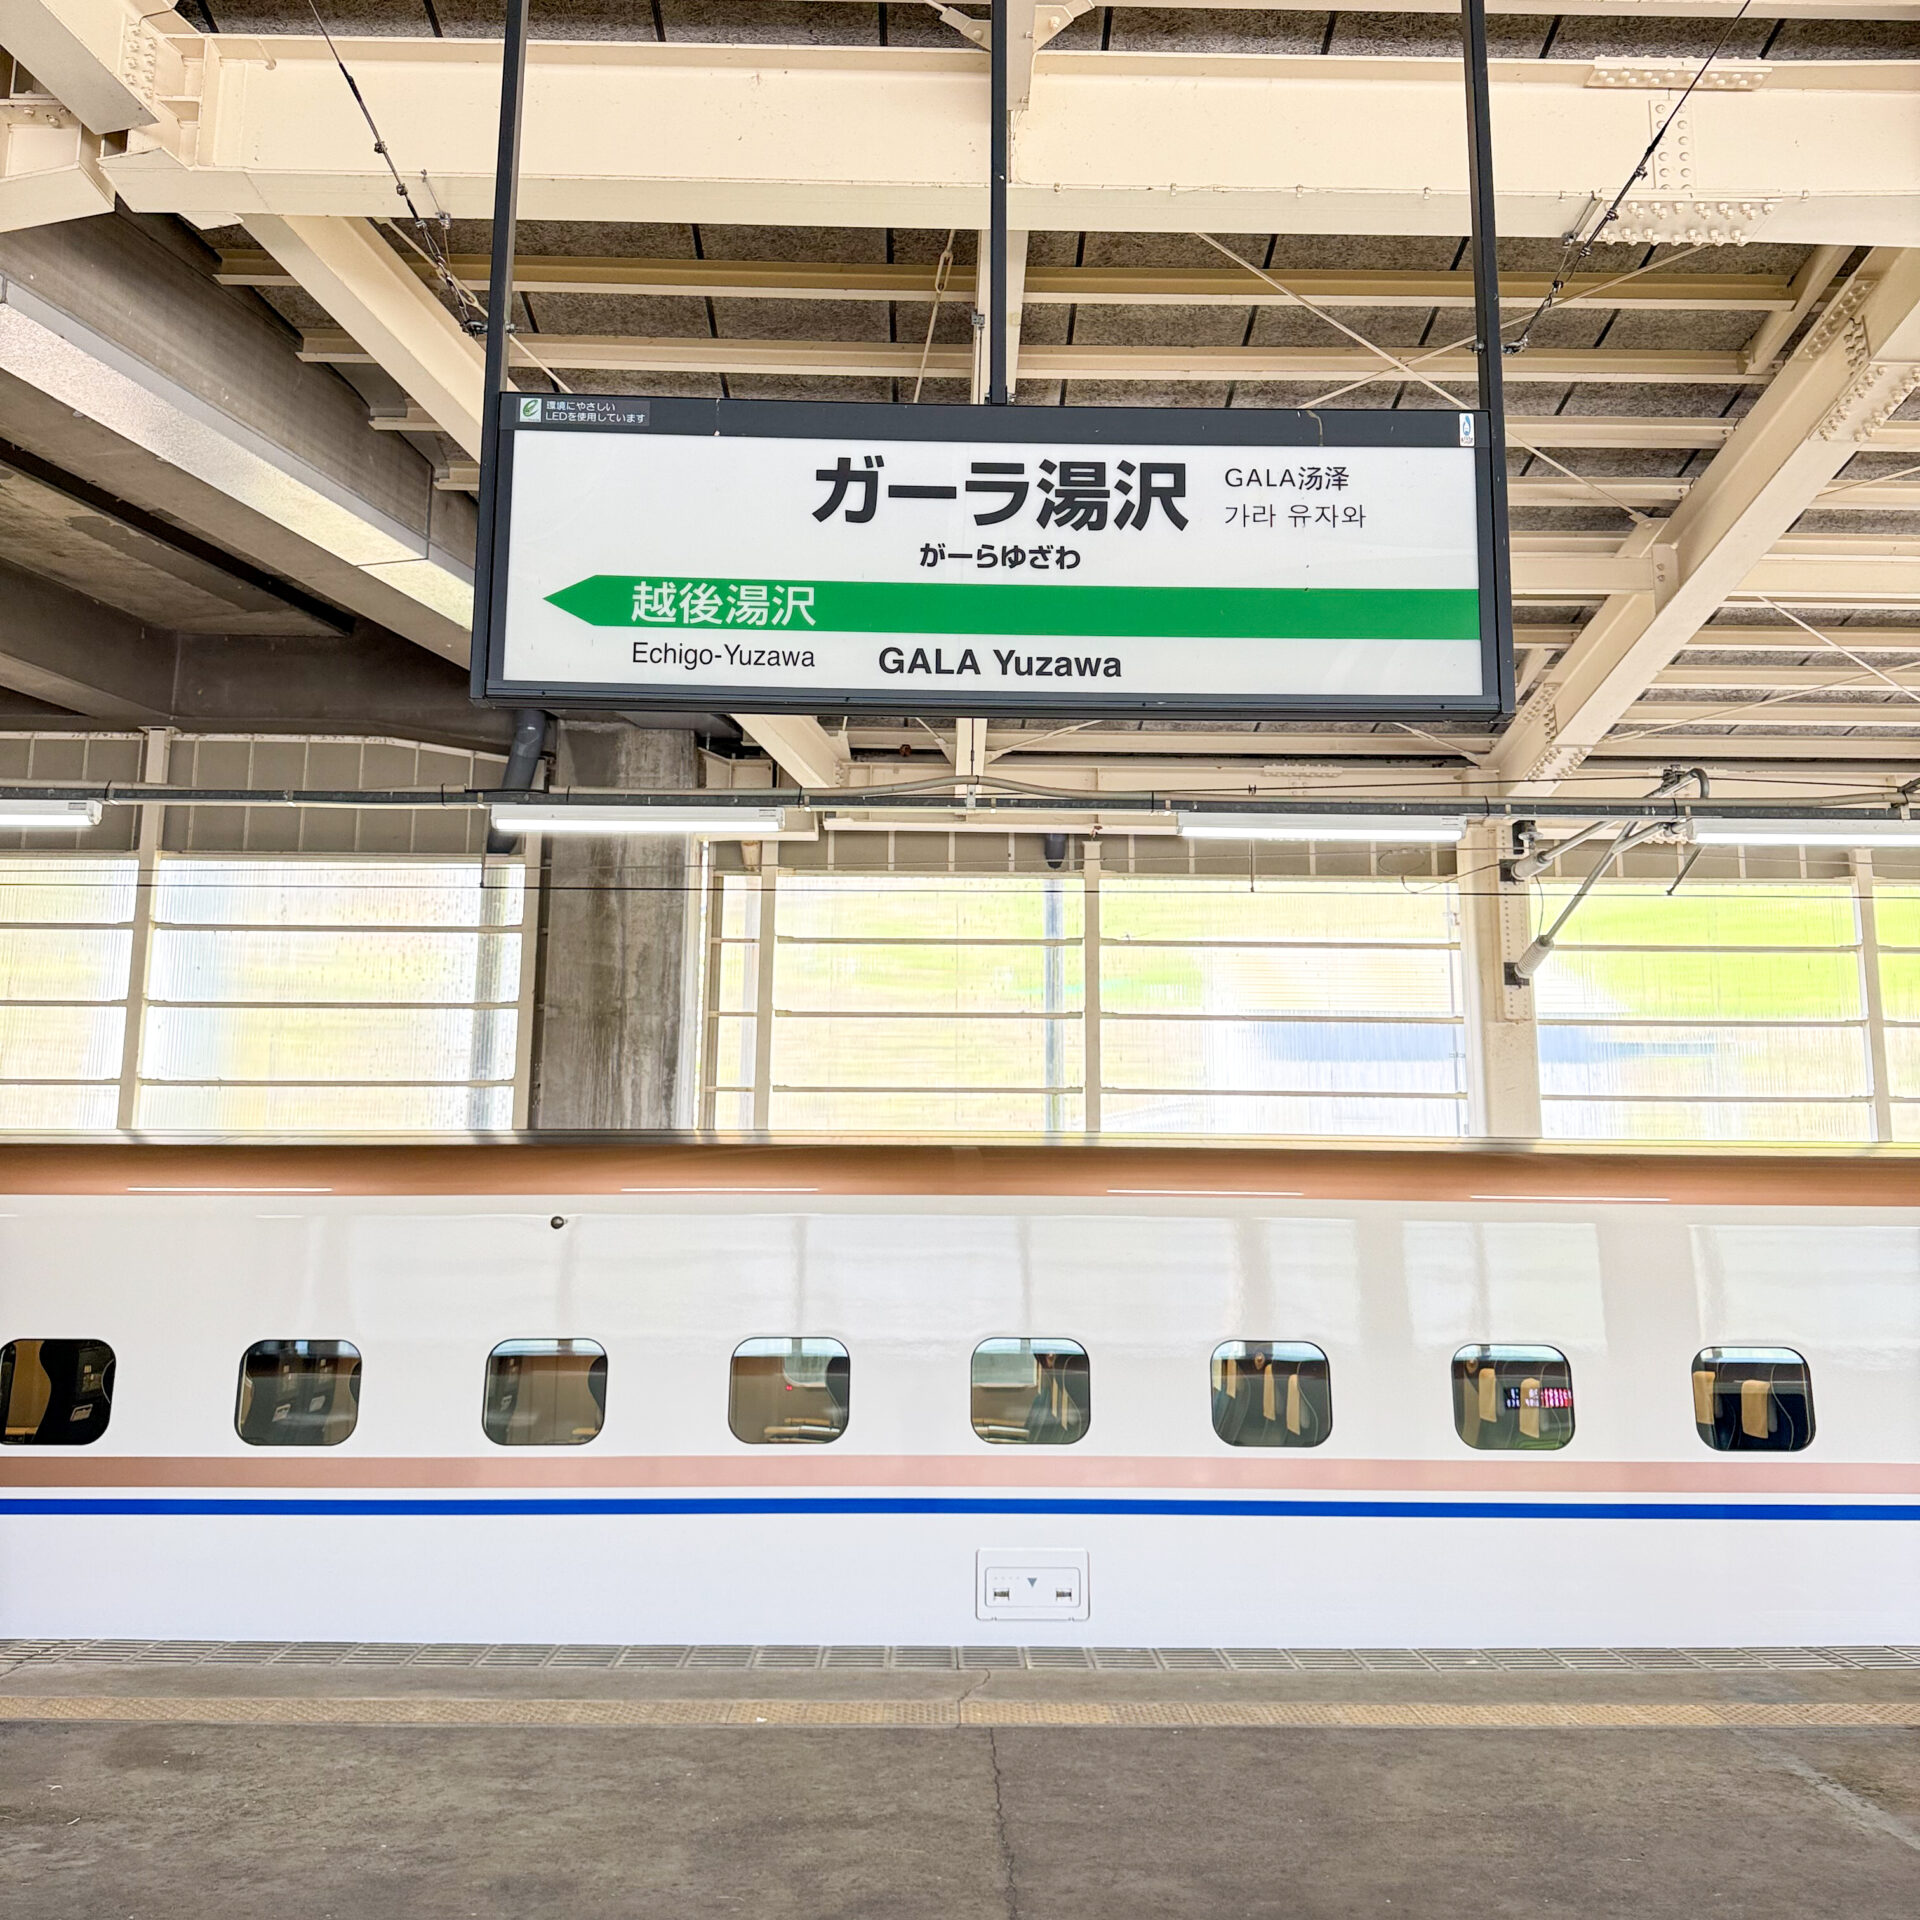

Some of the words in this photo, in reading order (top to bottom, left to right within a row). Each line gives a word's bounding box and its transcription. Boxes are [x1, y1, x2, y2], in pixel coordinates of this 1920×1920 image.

[545, 411, 646, 424] LEDを使用しています
[546, 400, 616, 412] 環境にやさしい
[1225, 466, 1350, 491] GALA汤泽
[812, 455, 1189, 532] ガーラ湯沢
[1225, 504, 1277, 528] 가라
[1288, 504, 1367, 528] 유자와
[919, 542, 1081, 570] がーらゆざわ
[631, 581, 817, 626] 越後湯沢
[632, 641, 816, 670] Echigo-Yuzawa
[879, 647, 982, 675] GALA
[992, 649, 1122, 678] Yuzawa
